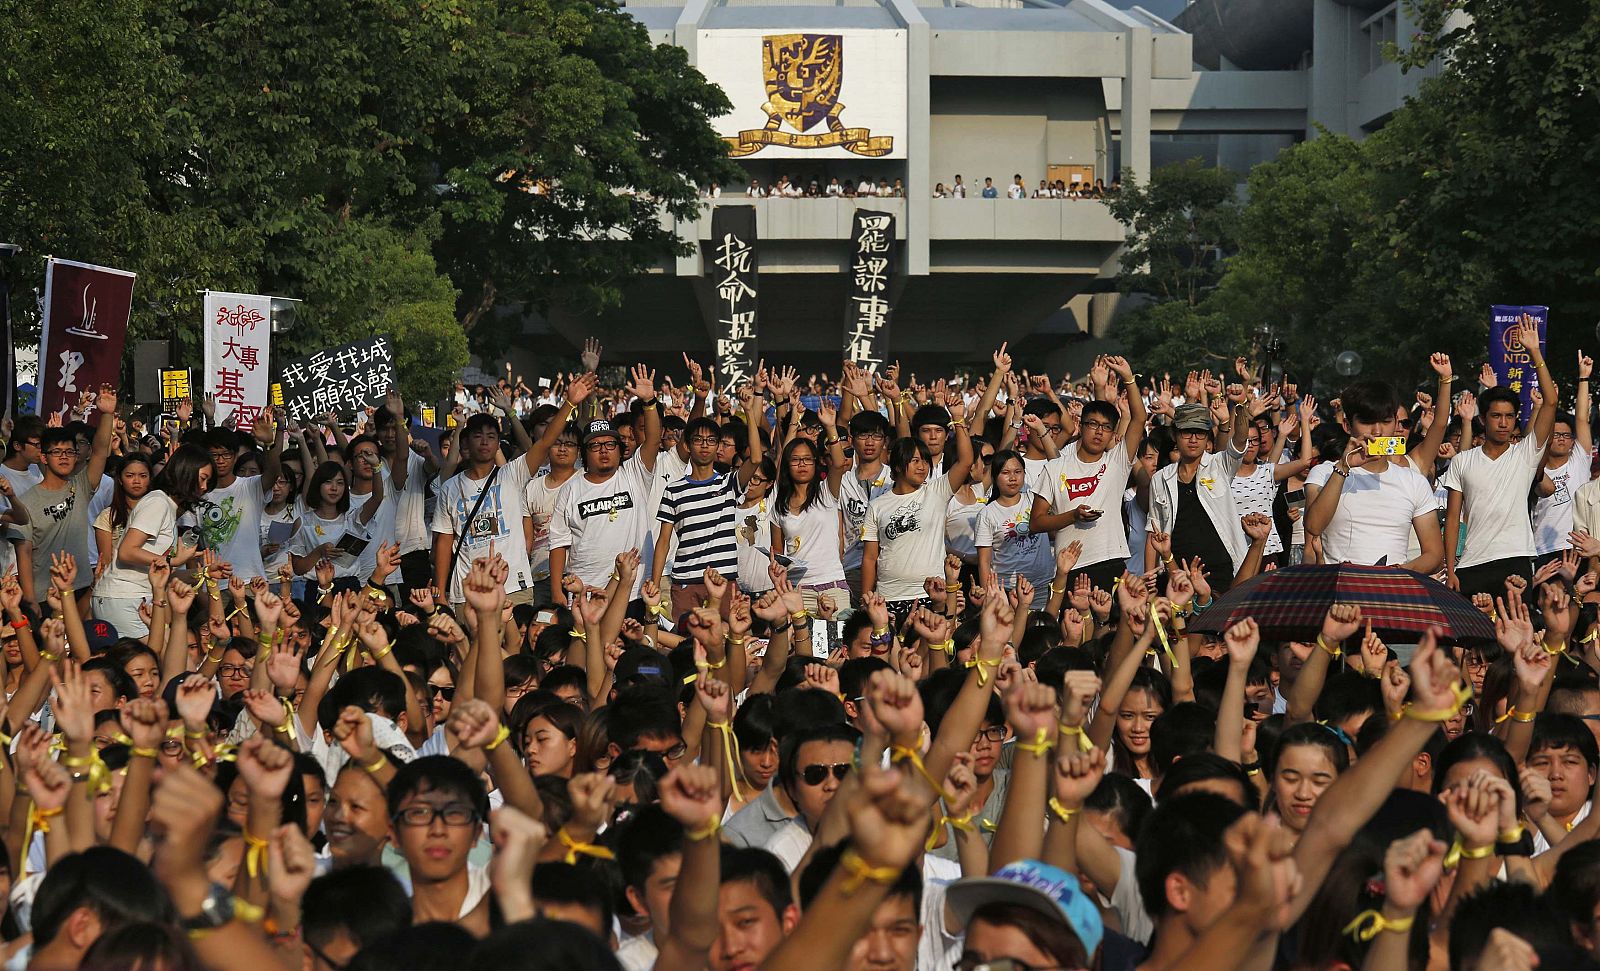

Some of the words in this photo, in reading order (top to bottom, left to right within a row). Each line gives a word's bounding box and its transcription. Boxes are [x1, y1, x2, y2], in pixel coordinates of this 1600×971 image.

[846, 216, 891, 375] 罷課事在
[282, 337, 392, 388] 我愛我城
[1503, 353, 1530, 364] NTD
[288, 363, 393, 421] 我願發聲
[582, 495, 626, 516] XLARGE
